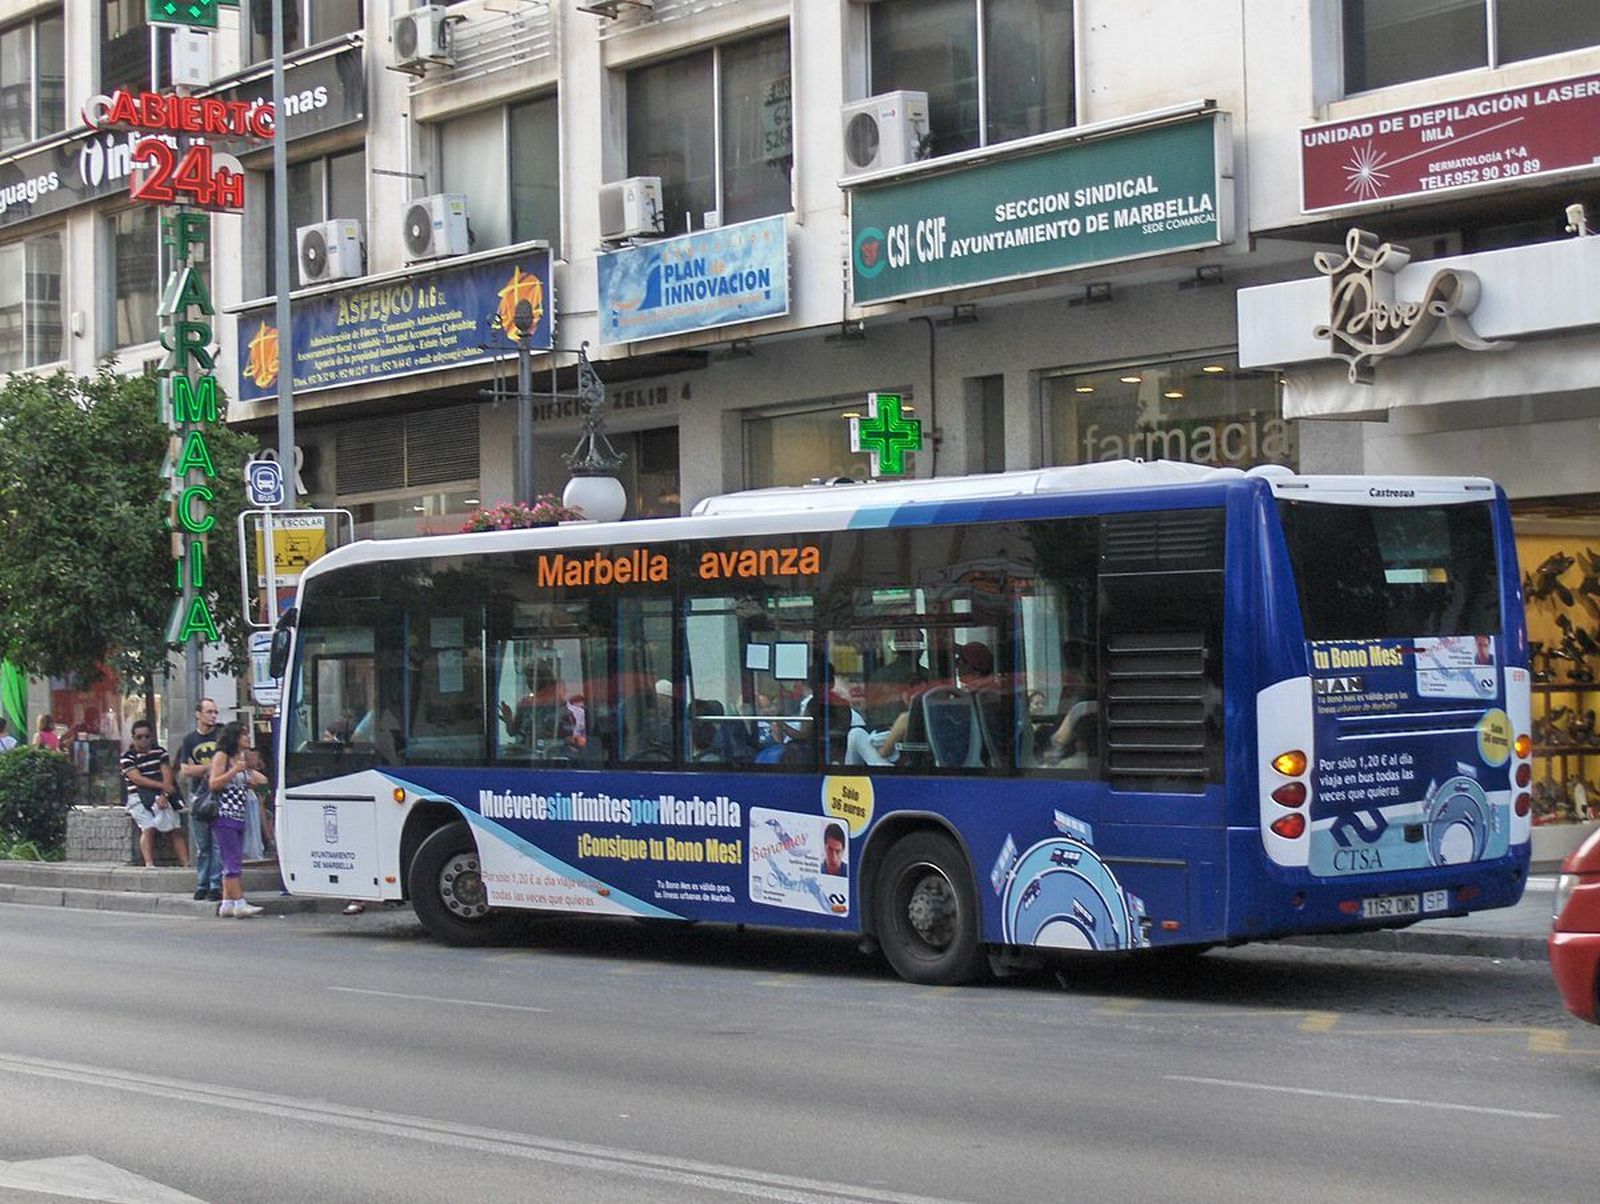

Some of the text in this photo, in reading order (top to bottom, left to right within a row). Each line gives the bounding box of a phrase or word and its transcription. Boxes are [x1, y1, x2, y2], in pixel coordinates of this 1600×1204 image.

[1304, 81, 1600, 147] UNIDAD DE DEPILACIÓN LASER
[1421, 127, 1454, 143] IMLA
[1429, 150, 1502, 173] DERMATOLOGÍA
[1482, 166, 1499, 180] 90
[1503, 162, 1519, 176] 30
[1523, 159, 1540, 173] 89
[995, 176, 1158, 222] SECCION SINDICAL
[951, 193, 1213, 257] AYUNTAMIENTO DE MARBELLA
[1142, 212, 1216, 235] SEDE COMARCAL
[887, 216, 947, 268] CSI CSIF
[665, 258, 706, 283] PLAN
[1083, 408, 1291, 463] farmacia
[538, 545, 820, 587] Marbella avanza
[1313, 649, 1329, 669] tu
[1330, 647, 1368, 668] Bono
[1313, 677, 1364, 694] MAN
[1319, 758, 1336, 771] Por
[1359, 755, 1379, 769] 1,20
[1381, 754, 1387, 765] €
[1389, 754, 1398, 765] al
[1319, 769, 1414, 788] viaja en bus todas las
[1319, 787, 1400, 802] veces que quieras
[831, 797, 866, 818] 36 euros
[577, 833, 742, 864] ¡Consigue tu Bono Mes!
[1333, 848, 1383, 871] CTSA
[1367, 898, 1393, 916] 1152
[1426, 891, 1446, 909] SP
